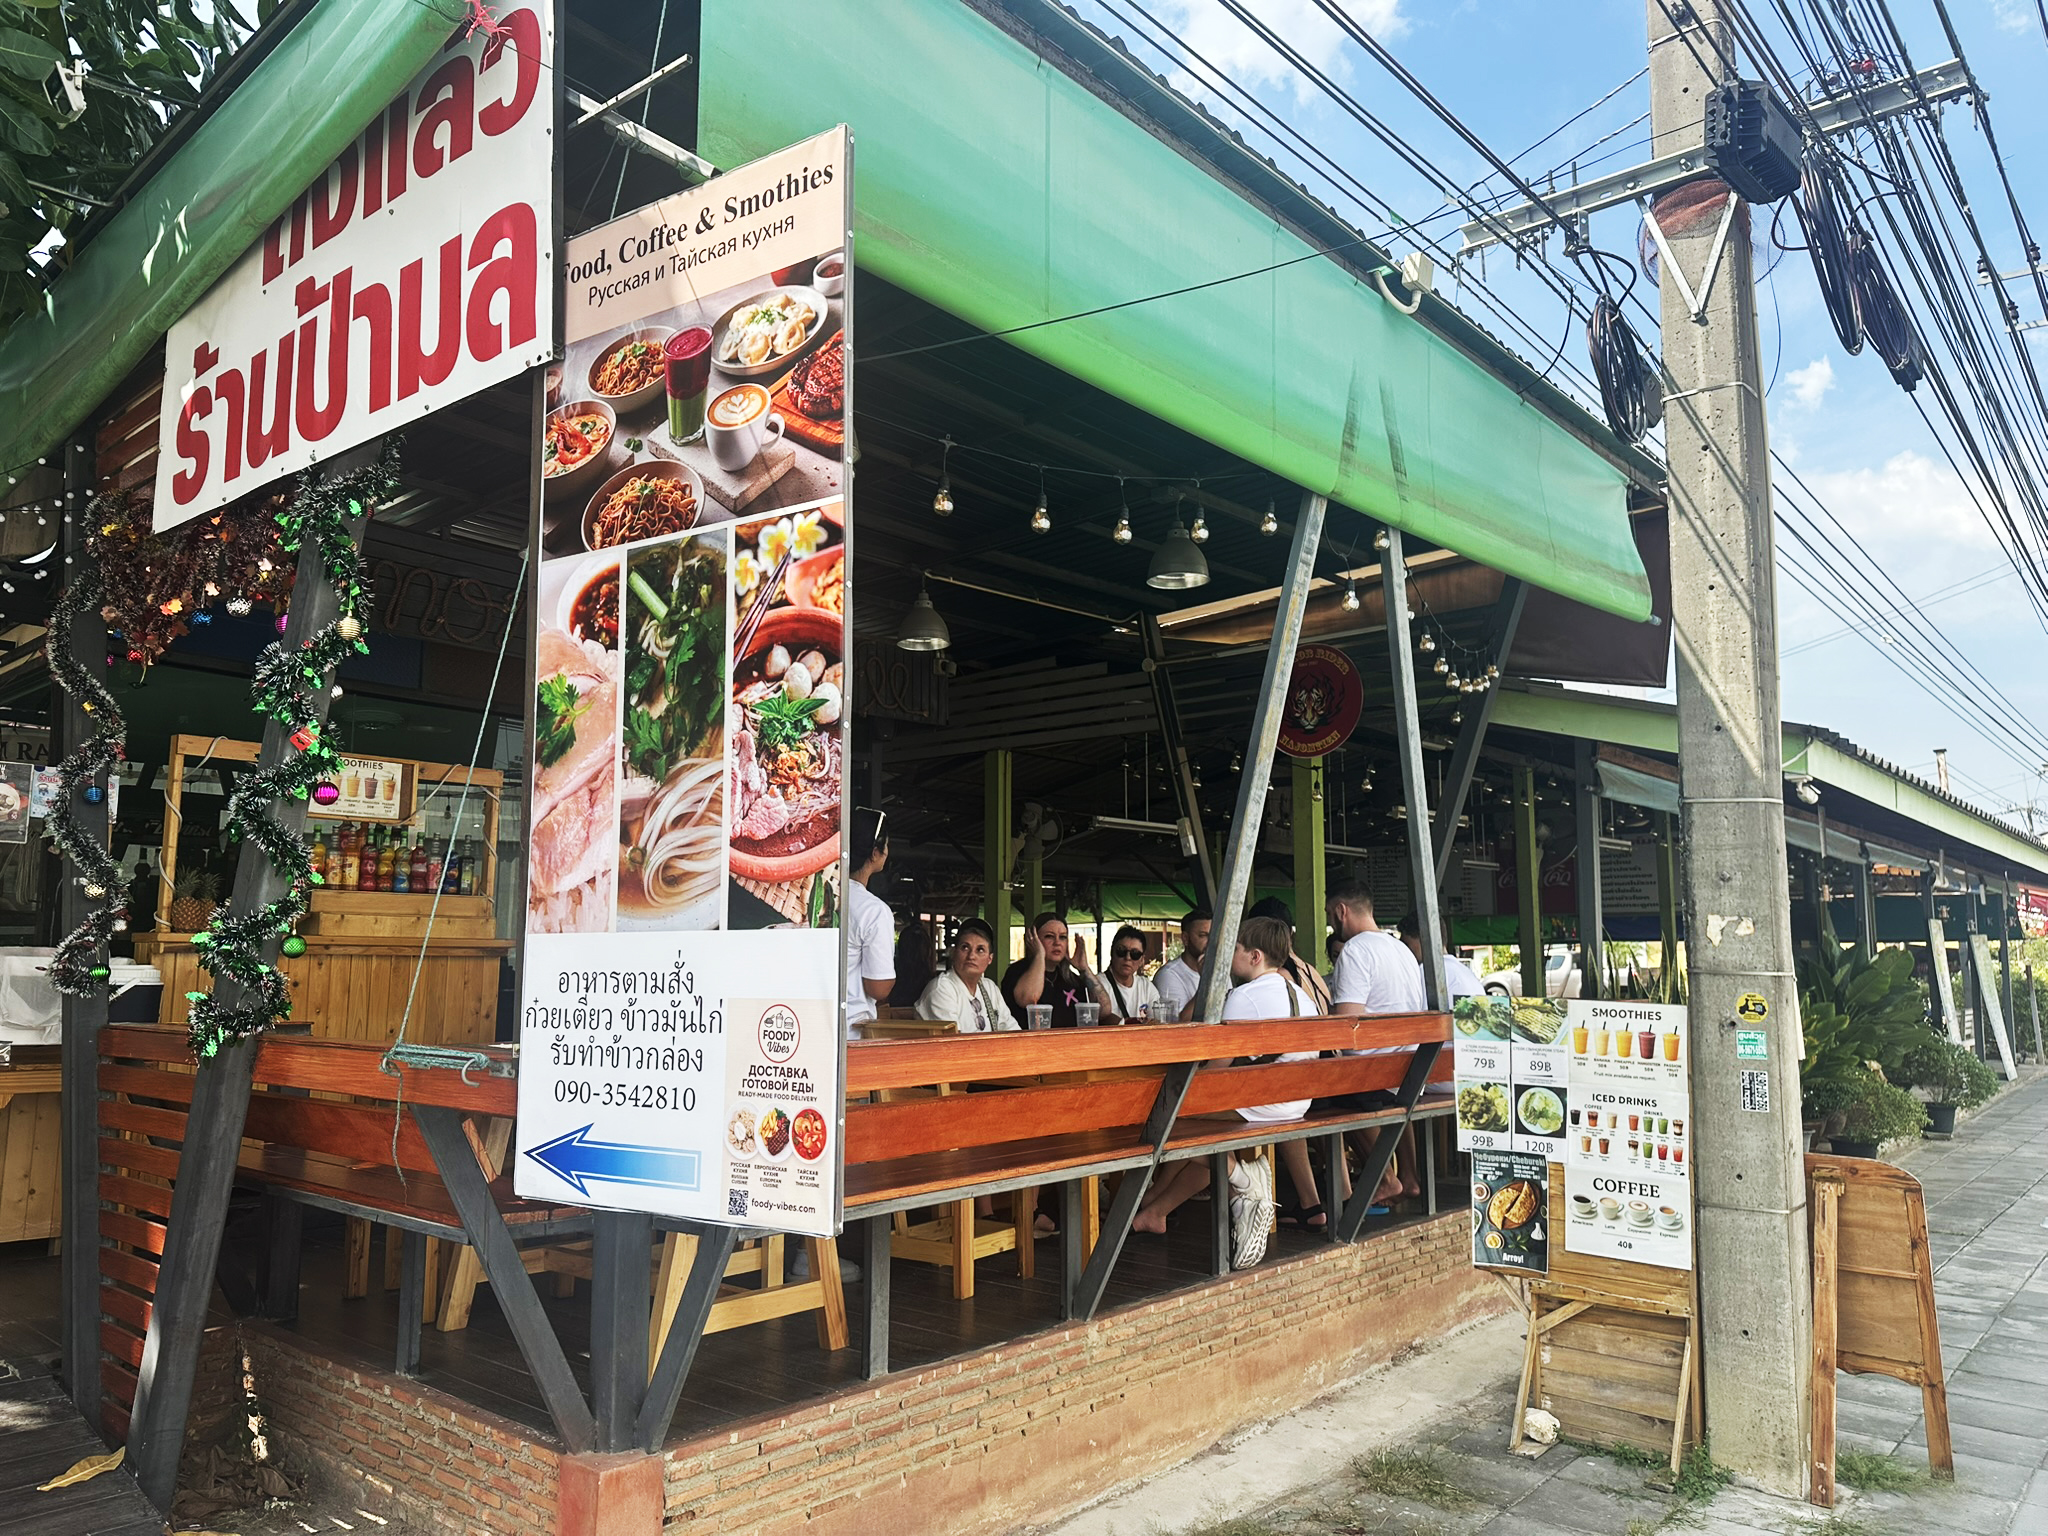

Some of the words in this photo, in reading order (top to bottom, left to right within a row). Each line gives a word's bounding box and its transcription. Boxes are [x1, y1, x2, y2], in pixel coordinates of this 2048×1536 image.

[619, 222, 688, 264] Coffee
[695, 207, 717, 233] &
[724, 164, 834, 224] Smothies
[589, 269, 650, 307] Русская
[655, 264, 665, 280] и
[669, 239, 737, 275] Тайская
[742, 215, 795, 248] кухня
[172, 202, 538, 506] ร้านป้ามล
[558, 950, 694, 994] อาหารตามสั่ง
[620, 995, 723, 1034] ข้าวมันไก่
[1592, 1007, 1662, 1021] SMOOTHIES
[763, 1030, 795, 1041] FOODY
[551, 1034, 703, 1073] รับทำข้าวกล่อง
[767, 1041, 790, 1053] Vibes
[749, 1065, 808, 1079] ДОСТАВКА
[742, 1079, 789, 1091] ГОТОВОЙ
[792, 1082, 814, 1094] ЕДЫ
[555, 1080, 696, 1111] 090-3542810
[738, 1091, 773, 1099] READY-MADE
[1592, 1093, 1616, 1103] ICED
[1618, 1096, 1658, 1108] DRINKS
[1593, 1177, 1660, 1198] COFFEE
[751, 1198, 816, 1214] foody-vibes.com
[1502, 1252, 1524, 1264] Arroy!
